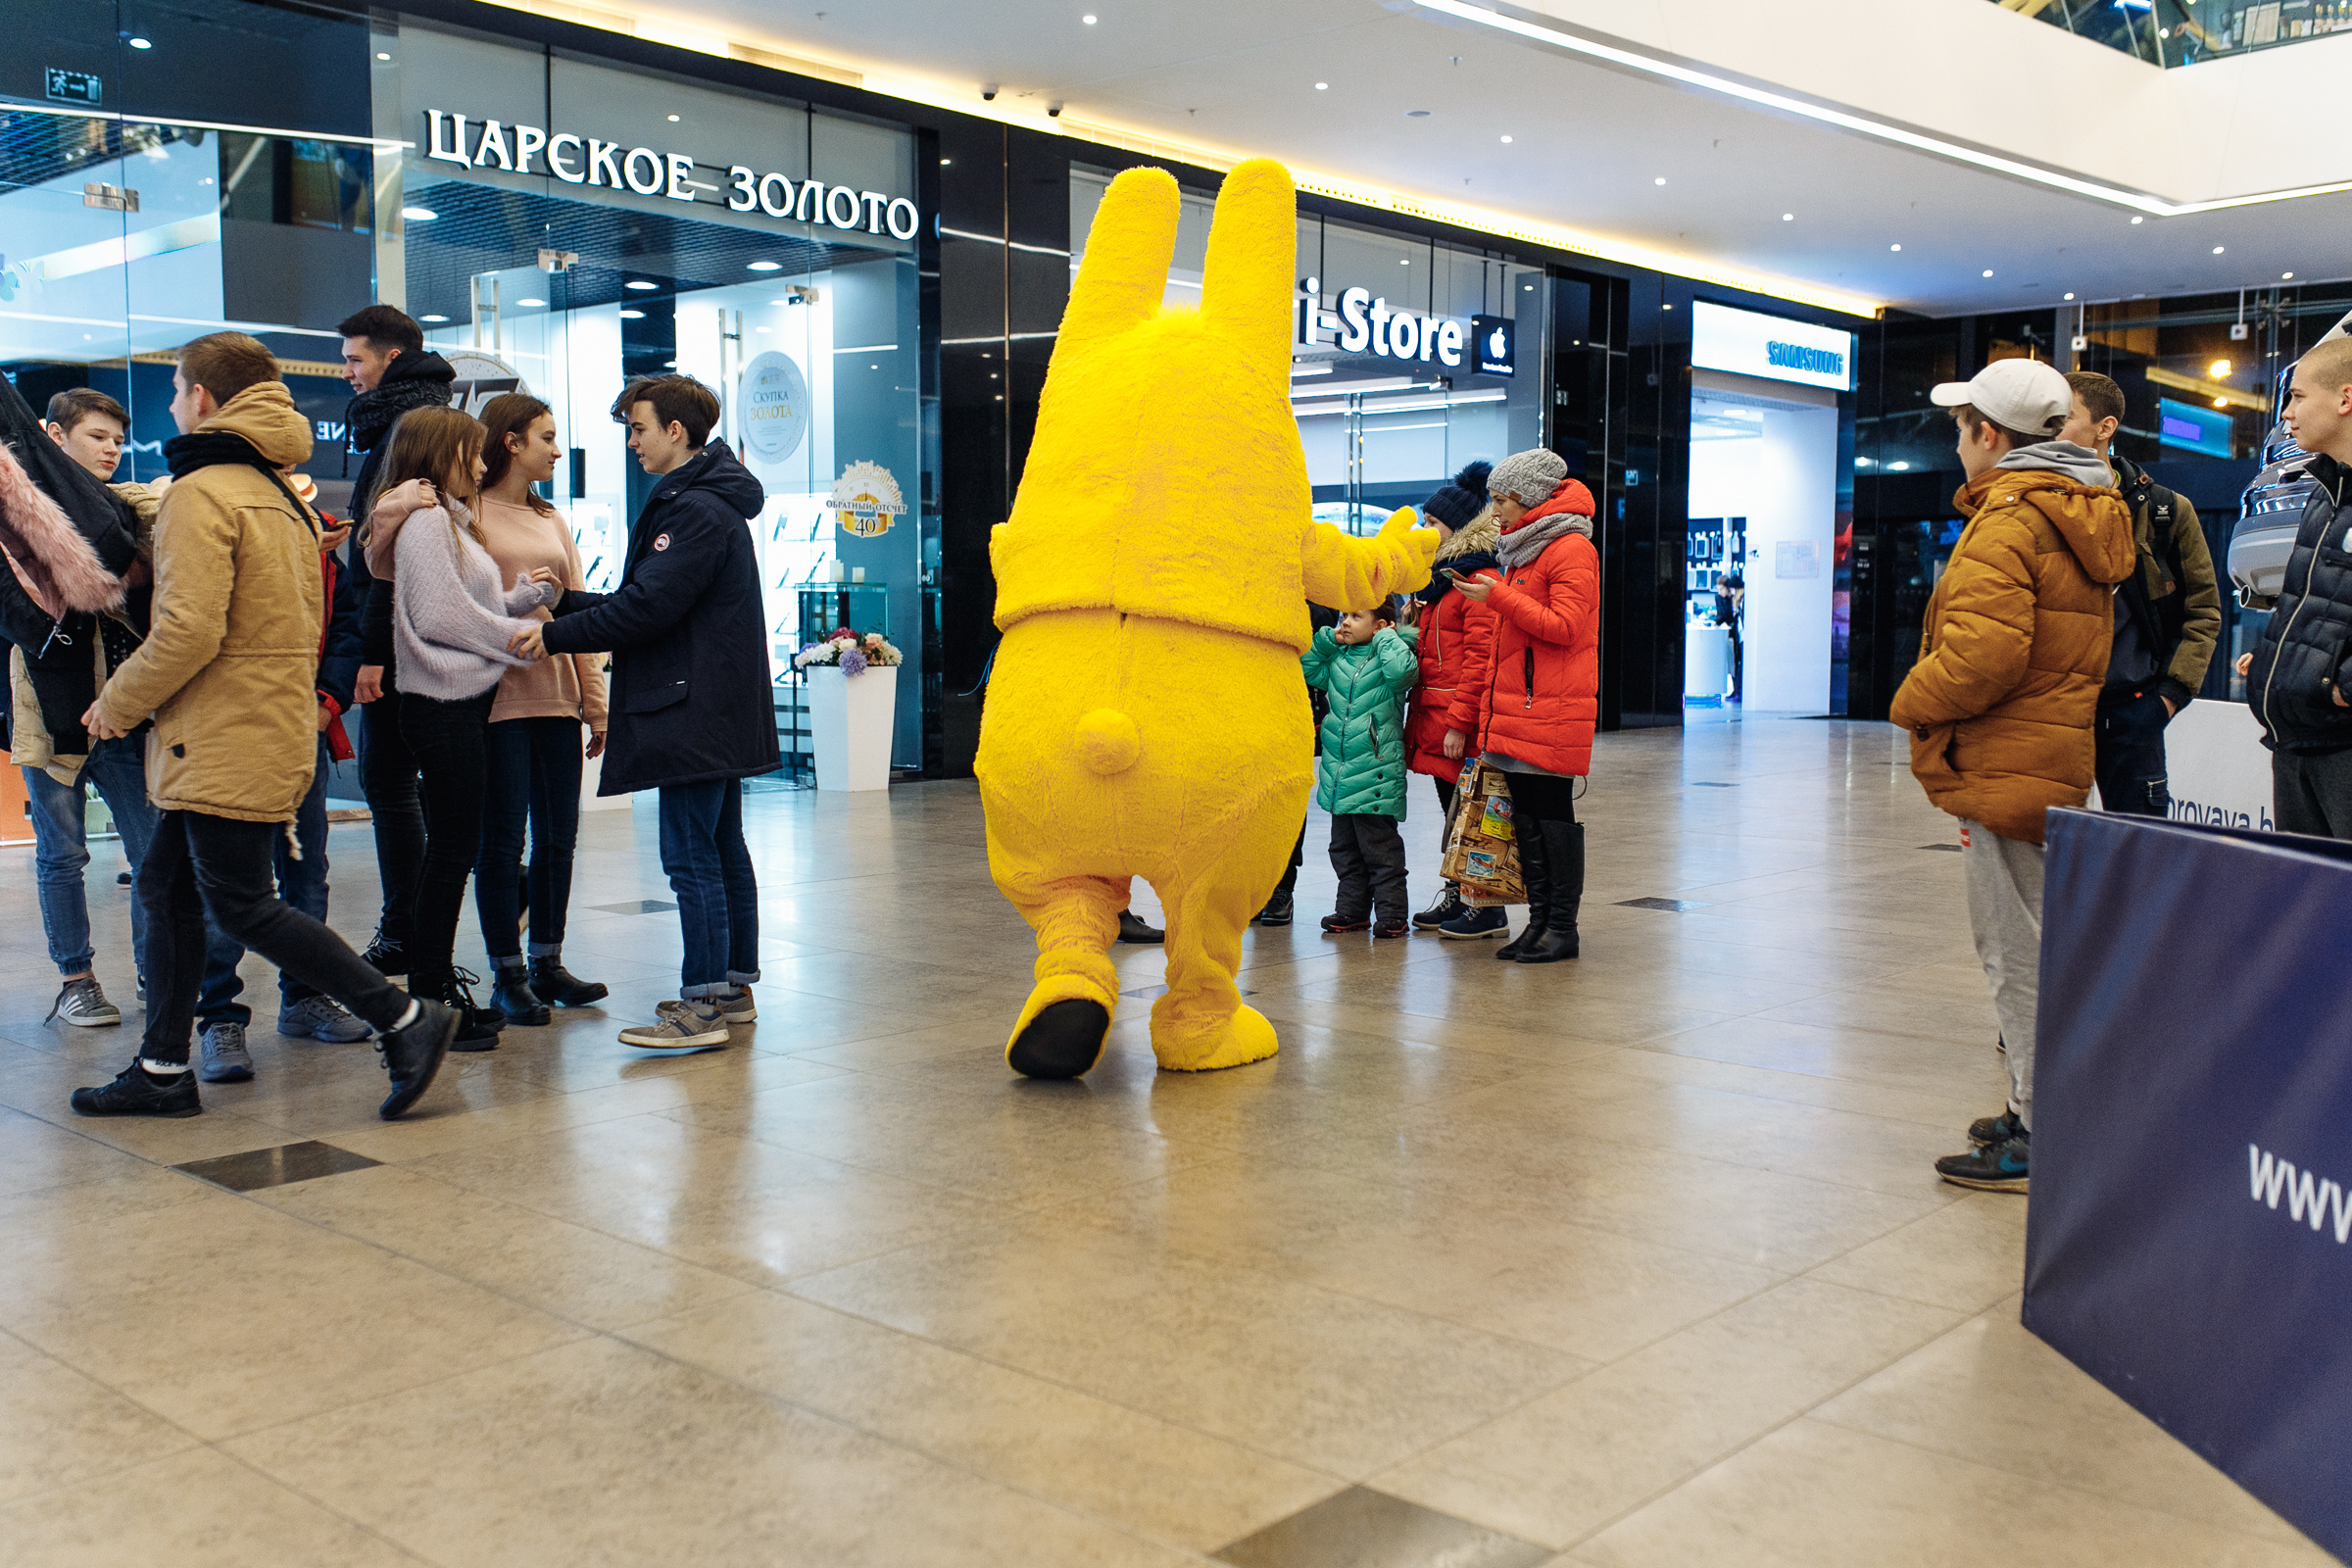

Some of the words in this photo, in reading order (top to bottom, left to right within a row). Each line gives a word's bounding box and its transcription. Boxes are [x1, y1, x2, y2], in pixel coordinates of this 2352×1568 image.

[426, 109, 696, 202] ЦАРСКОЕ
[728, 165, 919, 241] ЗОЛОТО
[1302, 276, 1463, 367] i-Store
[1767, 340, 1844, 376] SAMSUNG
[750, 405, 793, 420] ЗОЛОТА
[826, 499, 872, 511] ОБРАТНЫЙ
[875, 504, 907, 514] ОТСЧЕТ
[855, 517, 876, 537] 40
